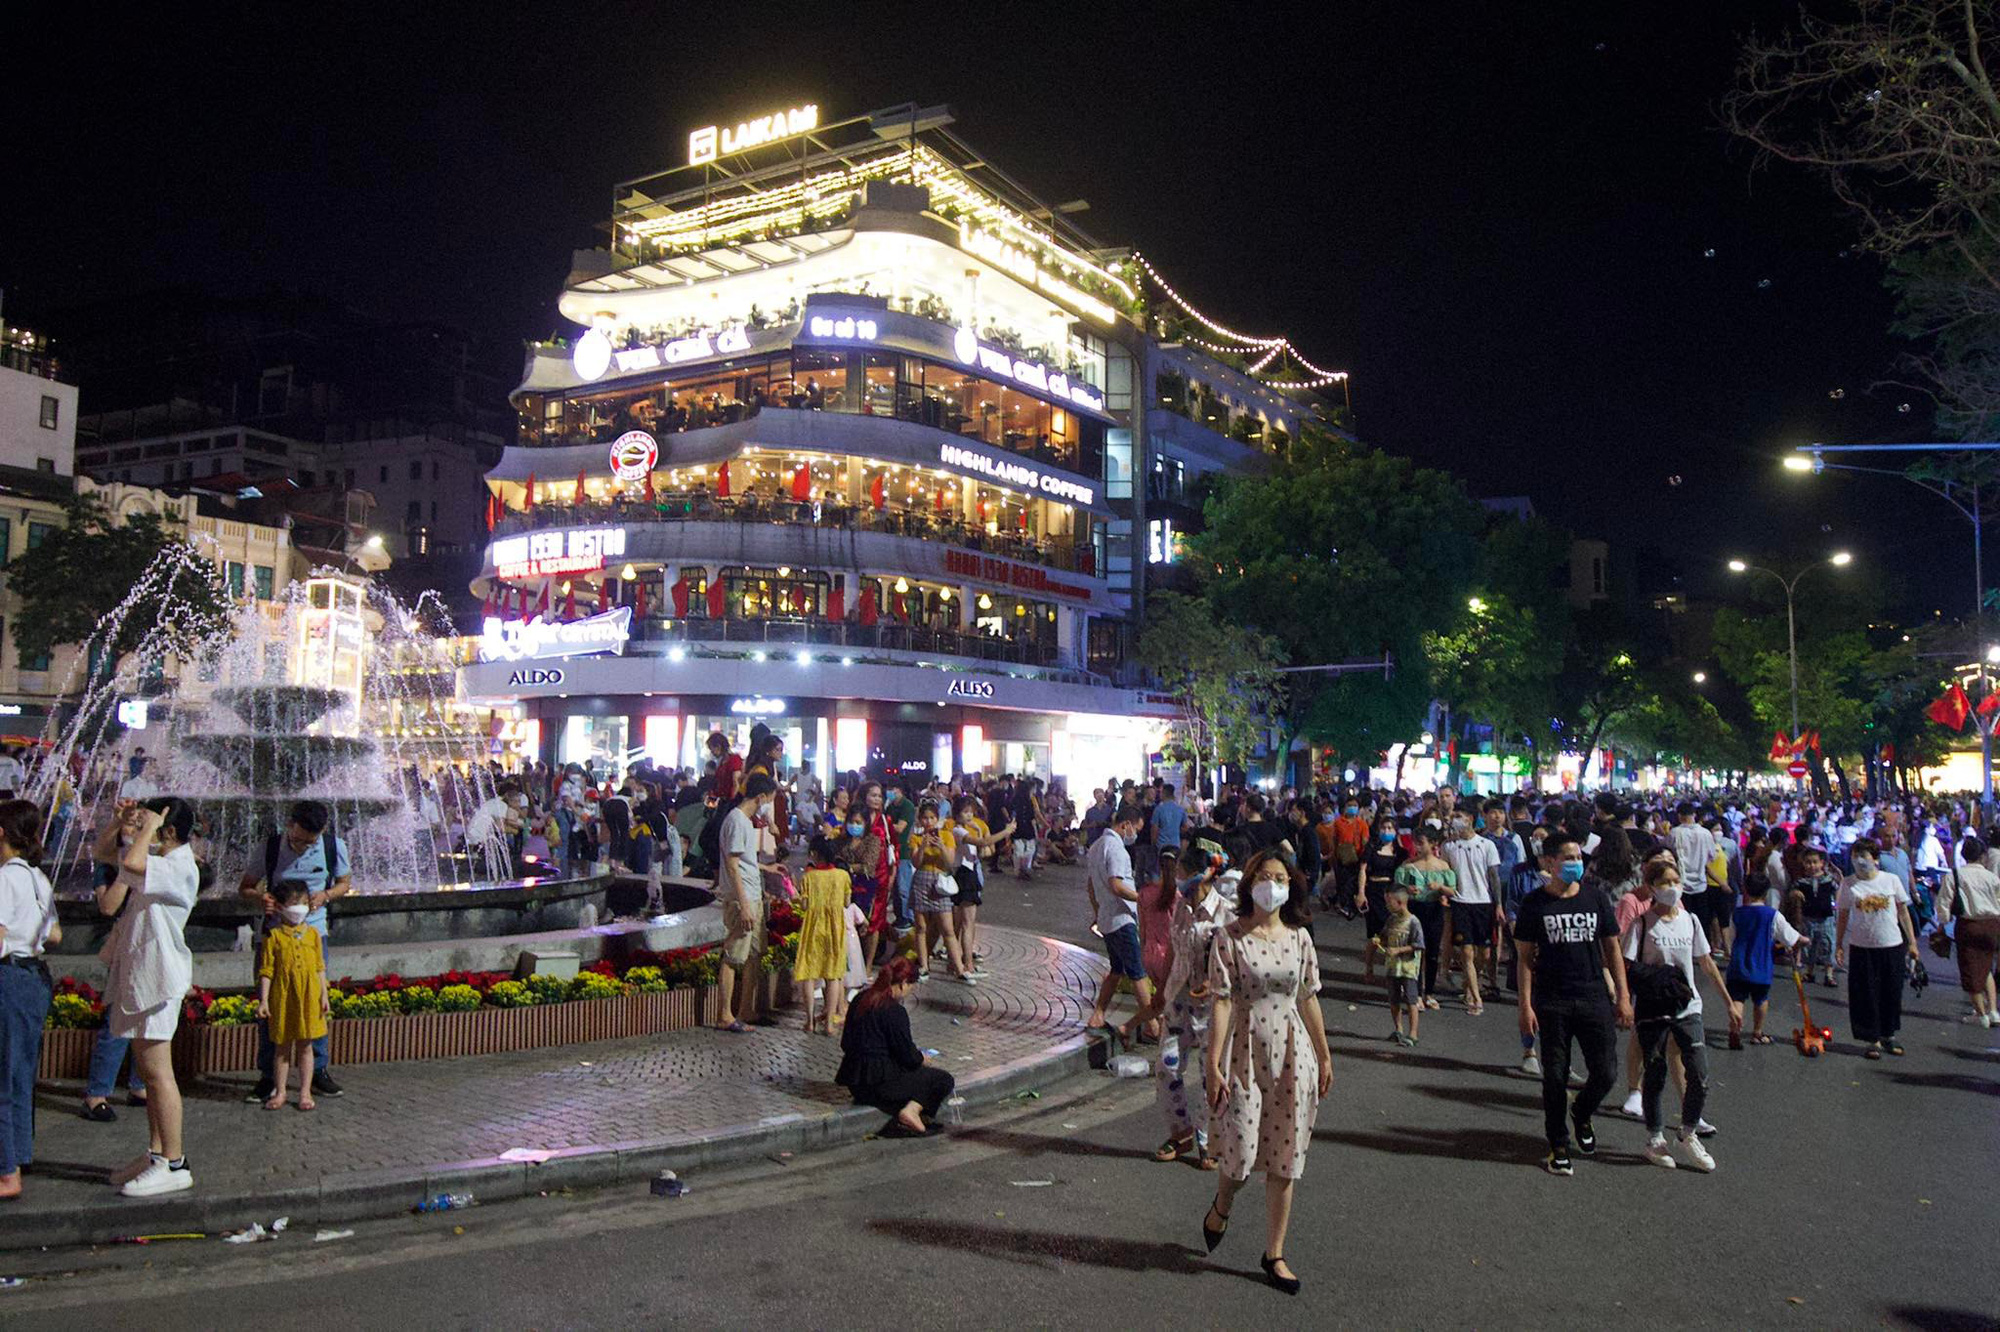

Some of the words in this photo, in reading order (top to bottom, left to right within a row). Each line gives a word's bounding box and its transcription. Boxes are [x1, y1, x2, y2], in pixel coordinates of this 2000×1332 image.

[940, 443, 1039, 489] HIGHLANDS
[1040, 475, 1093, 505] COFFEE
[509, 668, 565, 686] ALDO
[947, 679, 995, 698] ALDO
[731, 699, 786, 713] ALDO
[901, 760, 927, 771] ALDO
[1542, 912, 1598, 931] BITCH
[1546, 927, 1596, 944] WHERE
